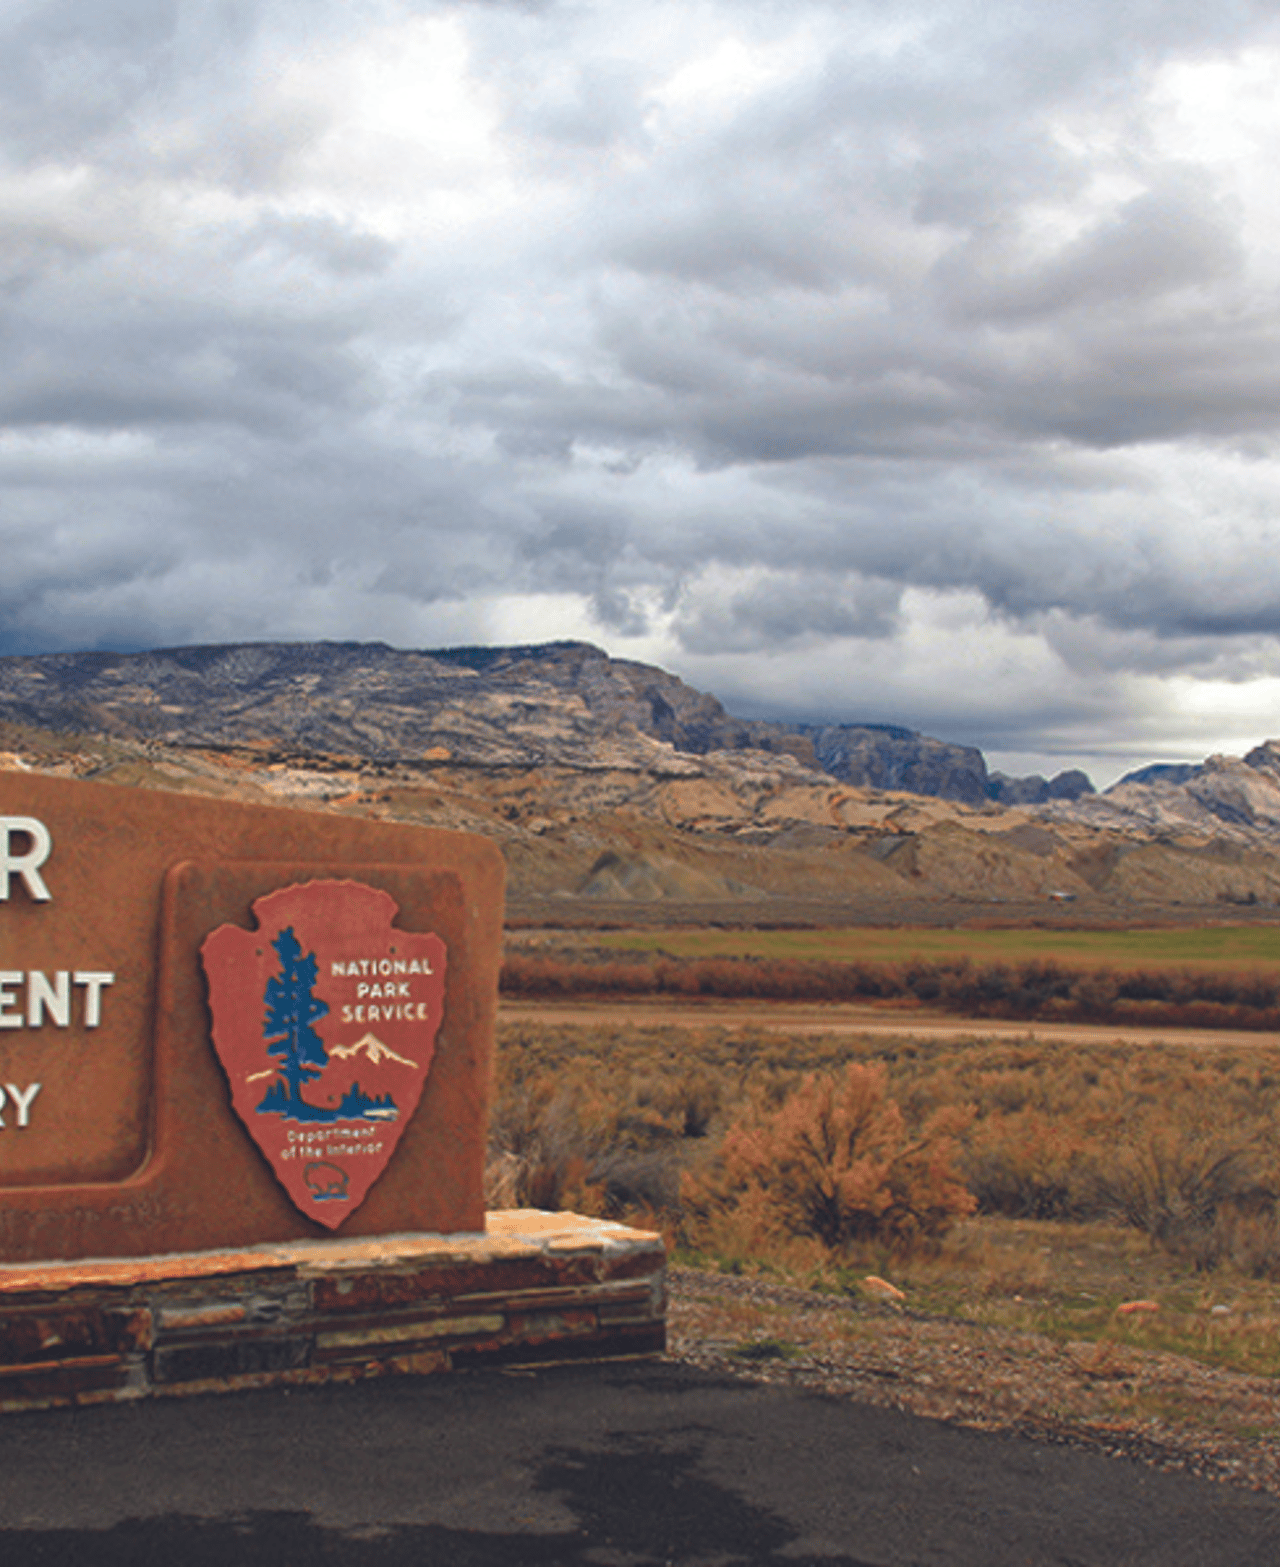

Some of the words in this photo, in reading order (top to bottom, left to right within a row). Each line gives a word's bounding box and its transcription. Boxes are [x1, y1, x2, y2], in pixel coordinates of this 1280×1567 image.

[331, 958, 434, 977] NATIONAL
[356, 981, 411, 999] PARK
[341, 1002, 428, 1023] SERVICE
[286, 1126, 377, 1143] Department
[279, 1145, 296, 1158] of
[300, 1145, 323, 1157] the
